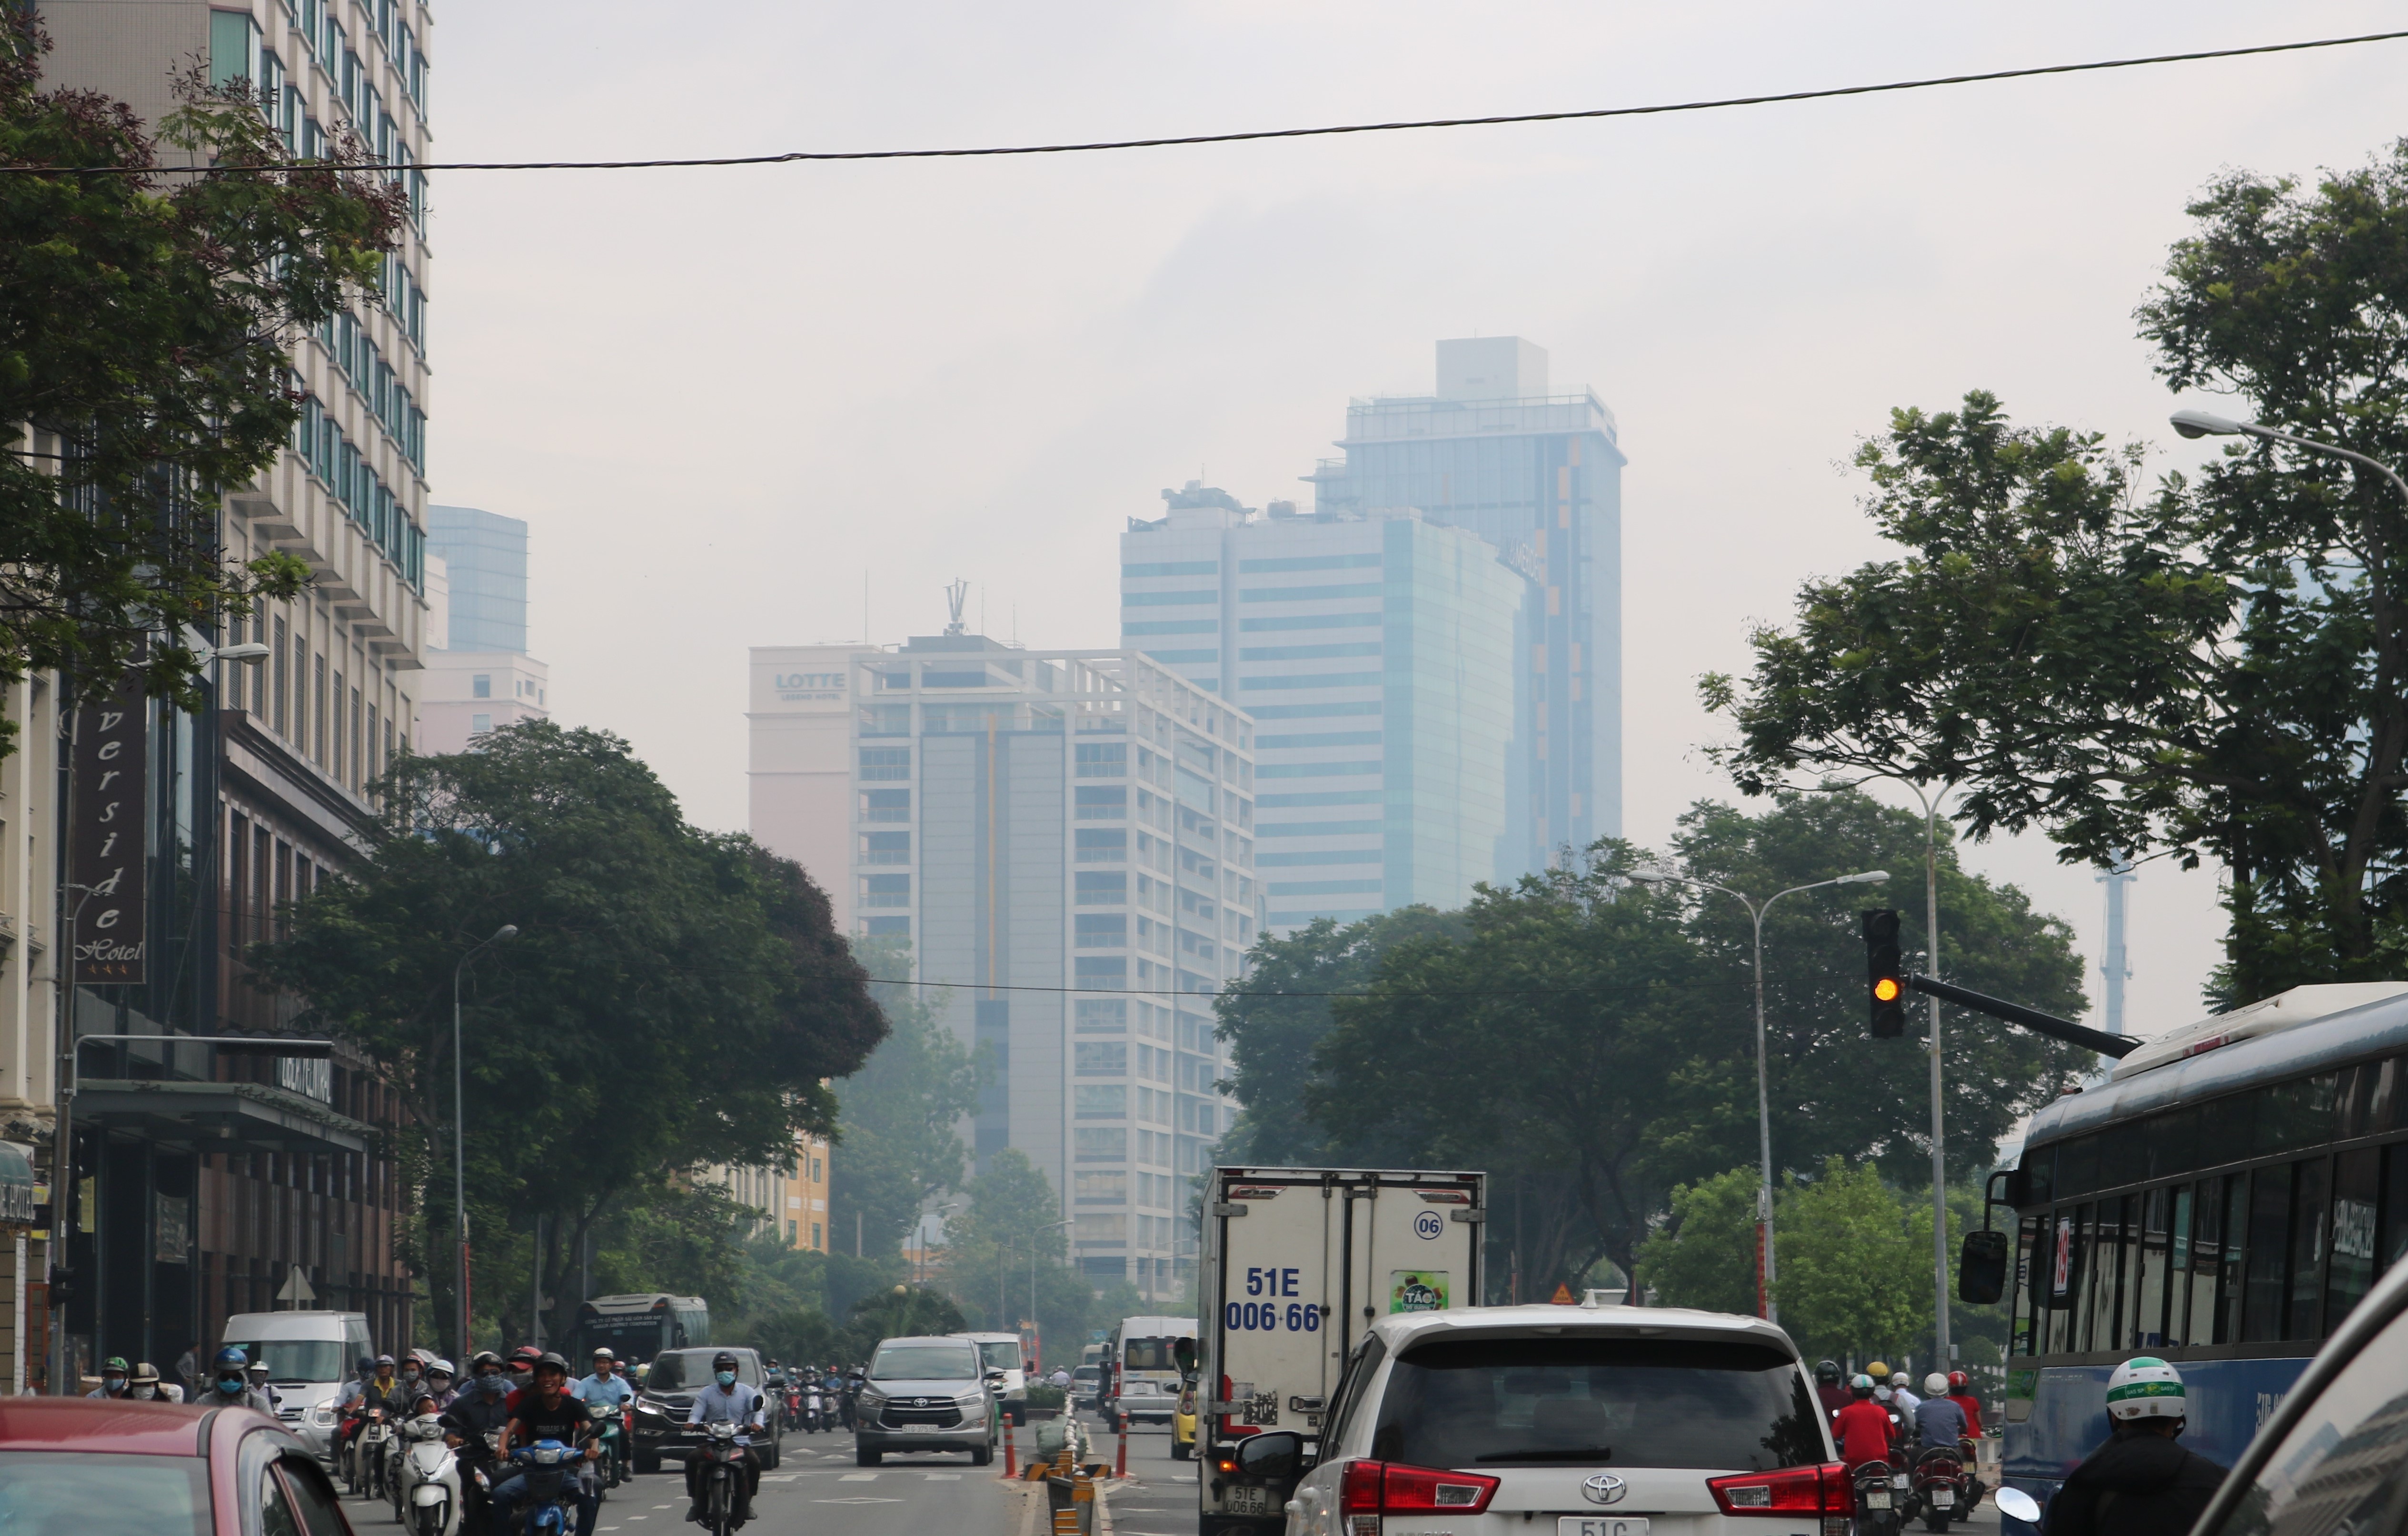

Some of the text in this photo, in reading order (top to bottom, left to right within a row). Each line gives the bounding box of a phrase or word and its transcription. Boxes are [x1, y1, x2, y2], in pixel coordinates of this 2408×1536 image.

[776, 673, 845, 687] LOTTE
[95, 696, 123, 929] verside
[75, 938, 143, 961] Hotel
[1419, 1219, 1439, 1233] 06
[2058, 1229, 2068, 1284] 19
[1246, 1268, 1299, 1297] 51E
[1405, 1290, 1432, 1303] TÁO
[1235, 1487, 1257, 1500] 51E
[1225, 1500, 1264, 1514] 006.66
